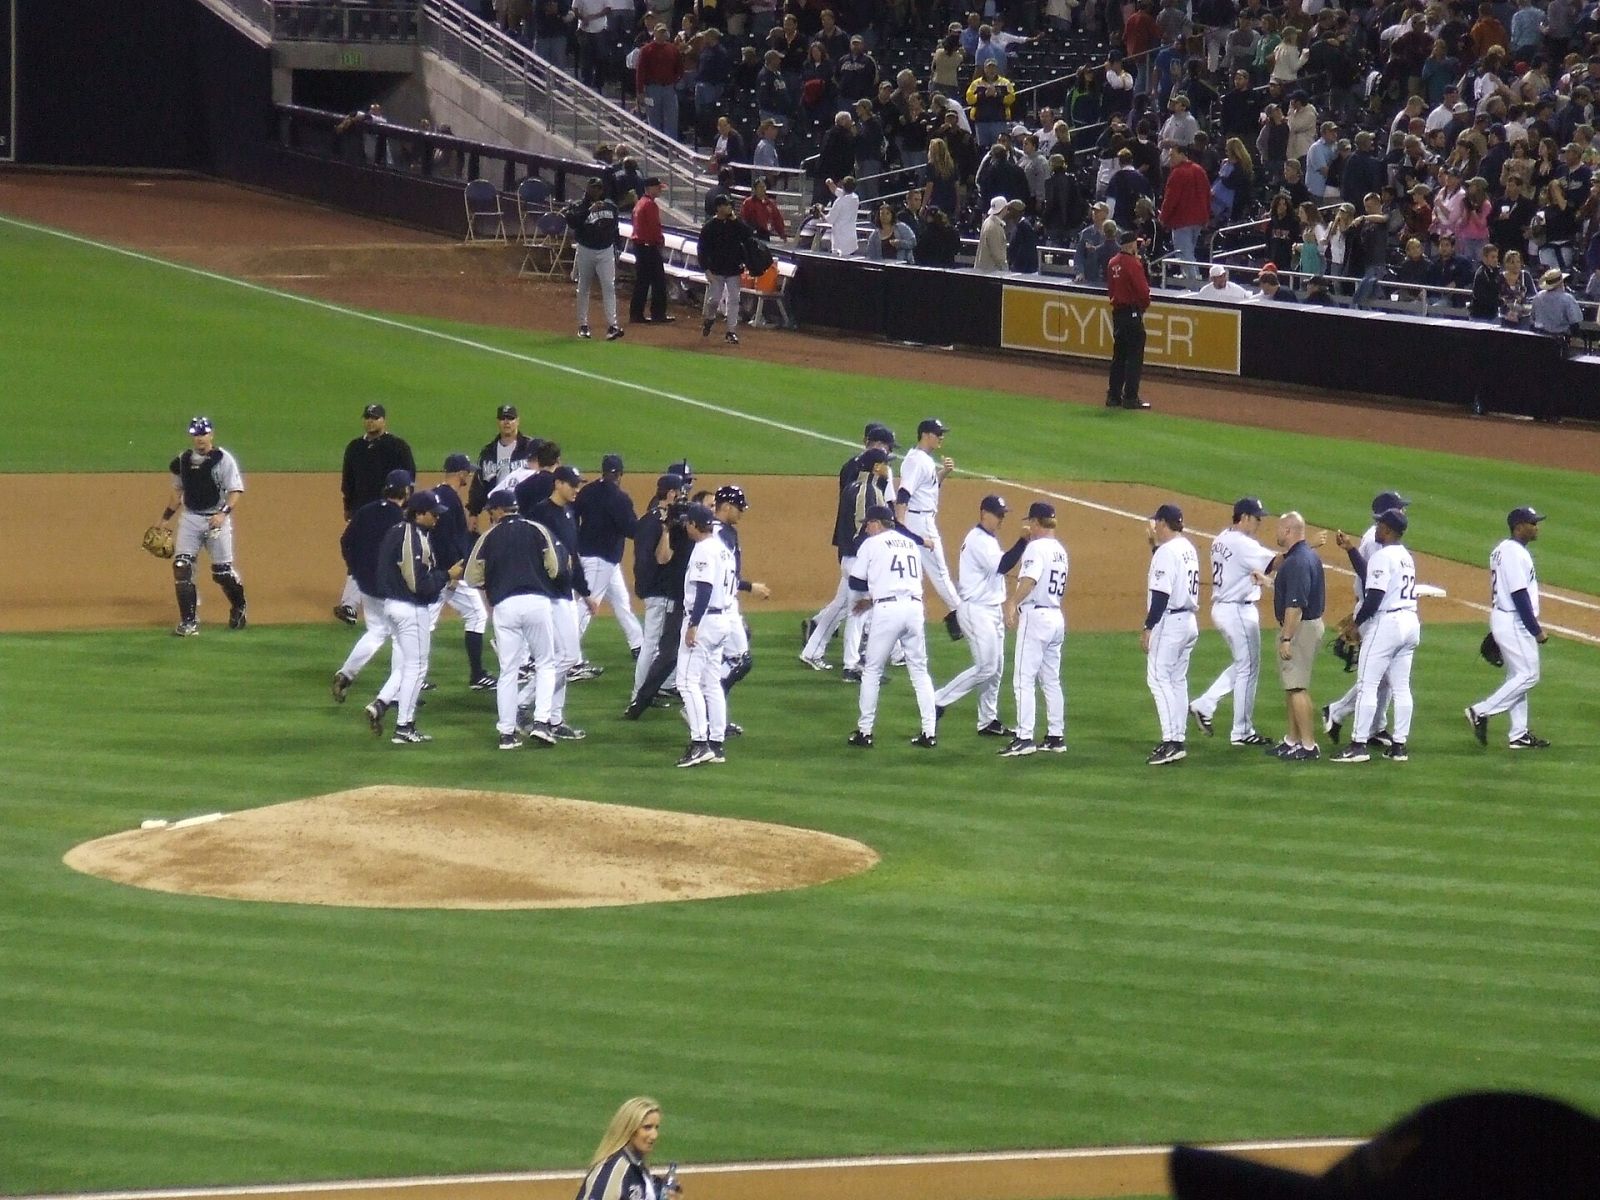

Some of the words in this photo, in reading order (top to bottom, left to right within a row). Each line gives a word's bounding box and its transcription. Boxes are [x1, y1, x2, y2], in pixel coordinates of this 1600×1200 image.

[890, 554, 918, 579] 40
[1048, 569, 1067, 597] 53
[1400, 574, 1416, 600] 22
